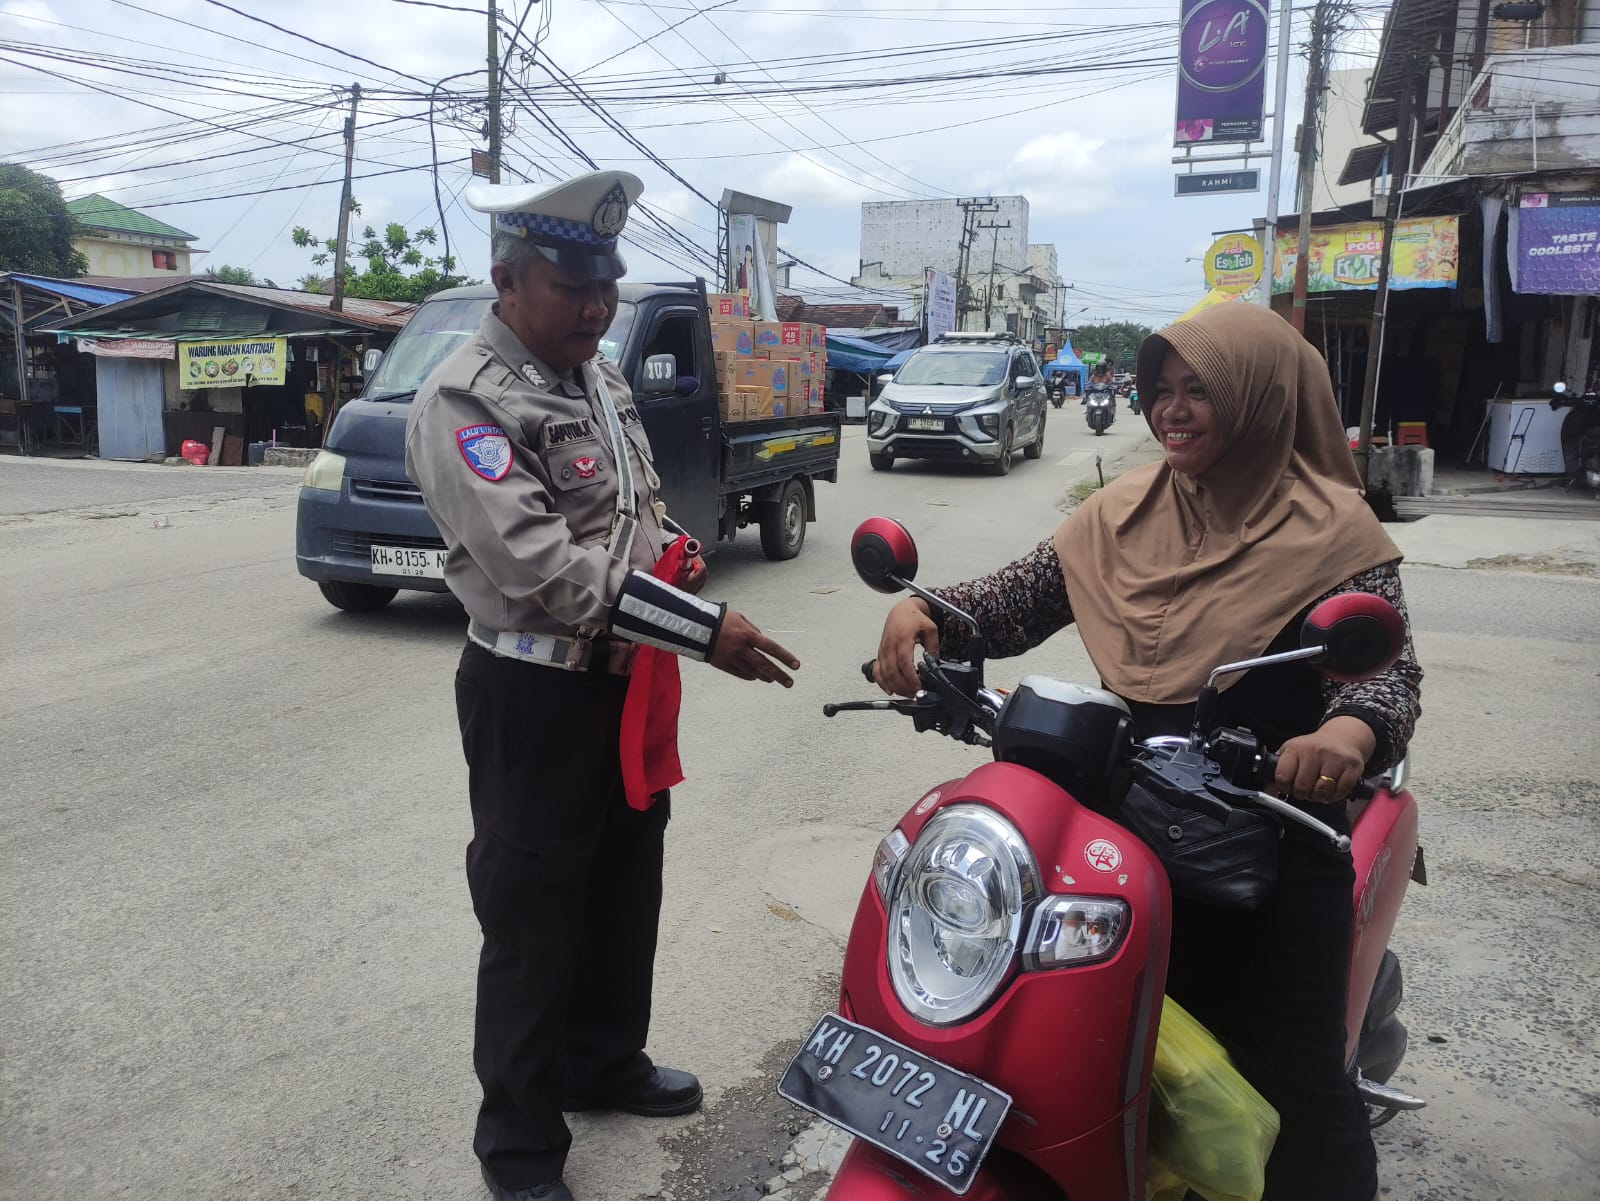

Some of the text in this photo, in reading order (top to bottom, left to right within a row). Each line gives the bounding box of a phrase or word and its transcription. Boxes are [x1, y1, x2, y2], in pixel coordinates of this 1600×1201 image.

[1201, 177, 1232, 187] RAHMI
[1552, 231, 1597, 244] TASTE
[1348, 241, 1380, 251] POCI
[1528, 244, 1592, 256] COOLEST
[1216, 253, 1252, 269] Es Teh
[785, 331, 796, 339] 48
[187, 345, 216, 358] WARUNG
[217, 343, 241, 356] MAKAN
[241, 342, 275, 354] KARTINAH
[460, 426, 479, 439] LALU
[372, 548, 449, 569] KH 8155 N
[806, 1021, 988, 1142] KH 2072 NL
